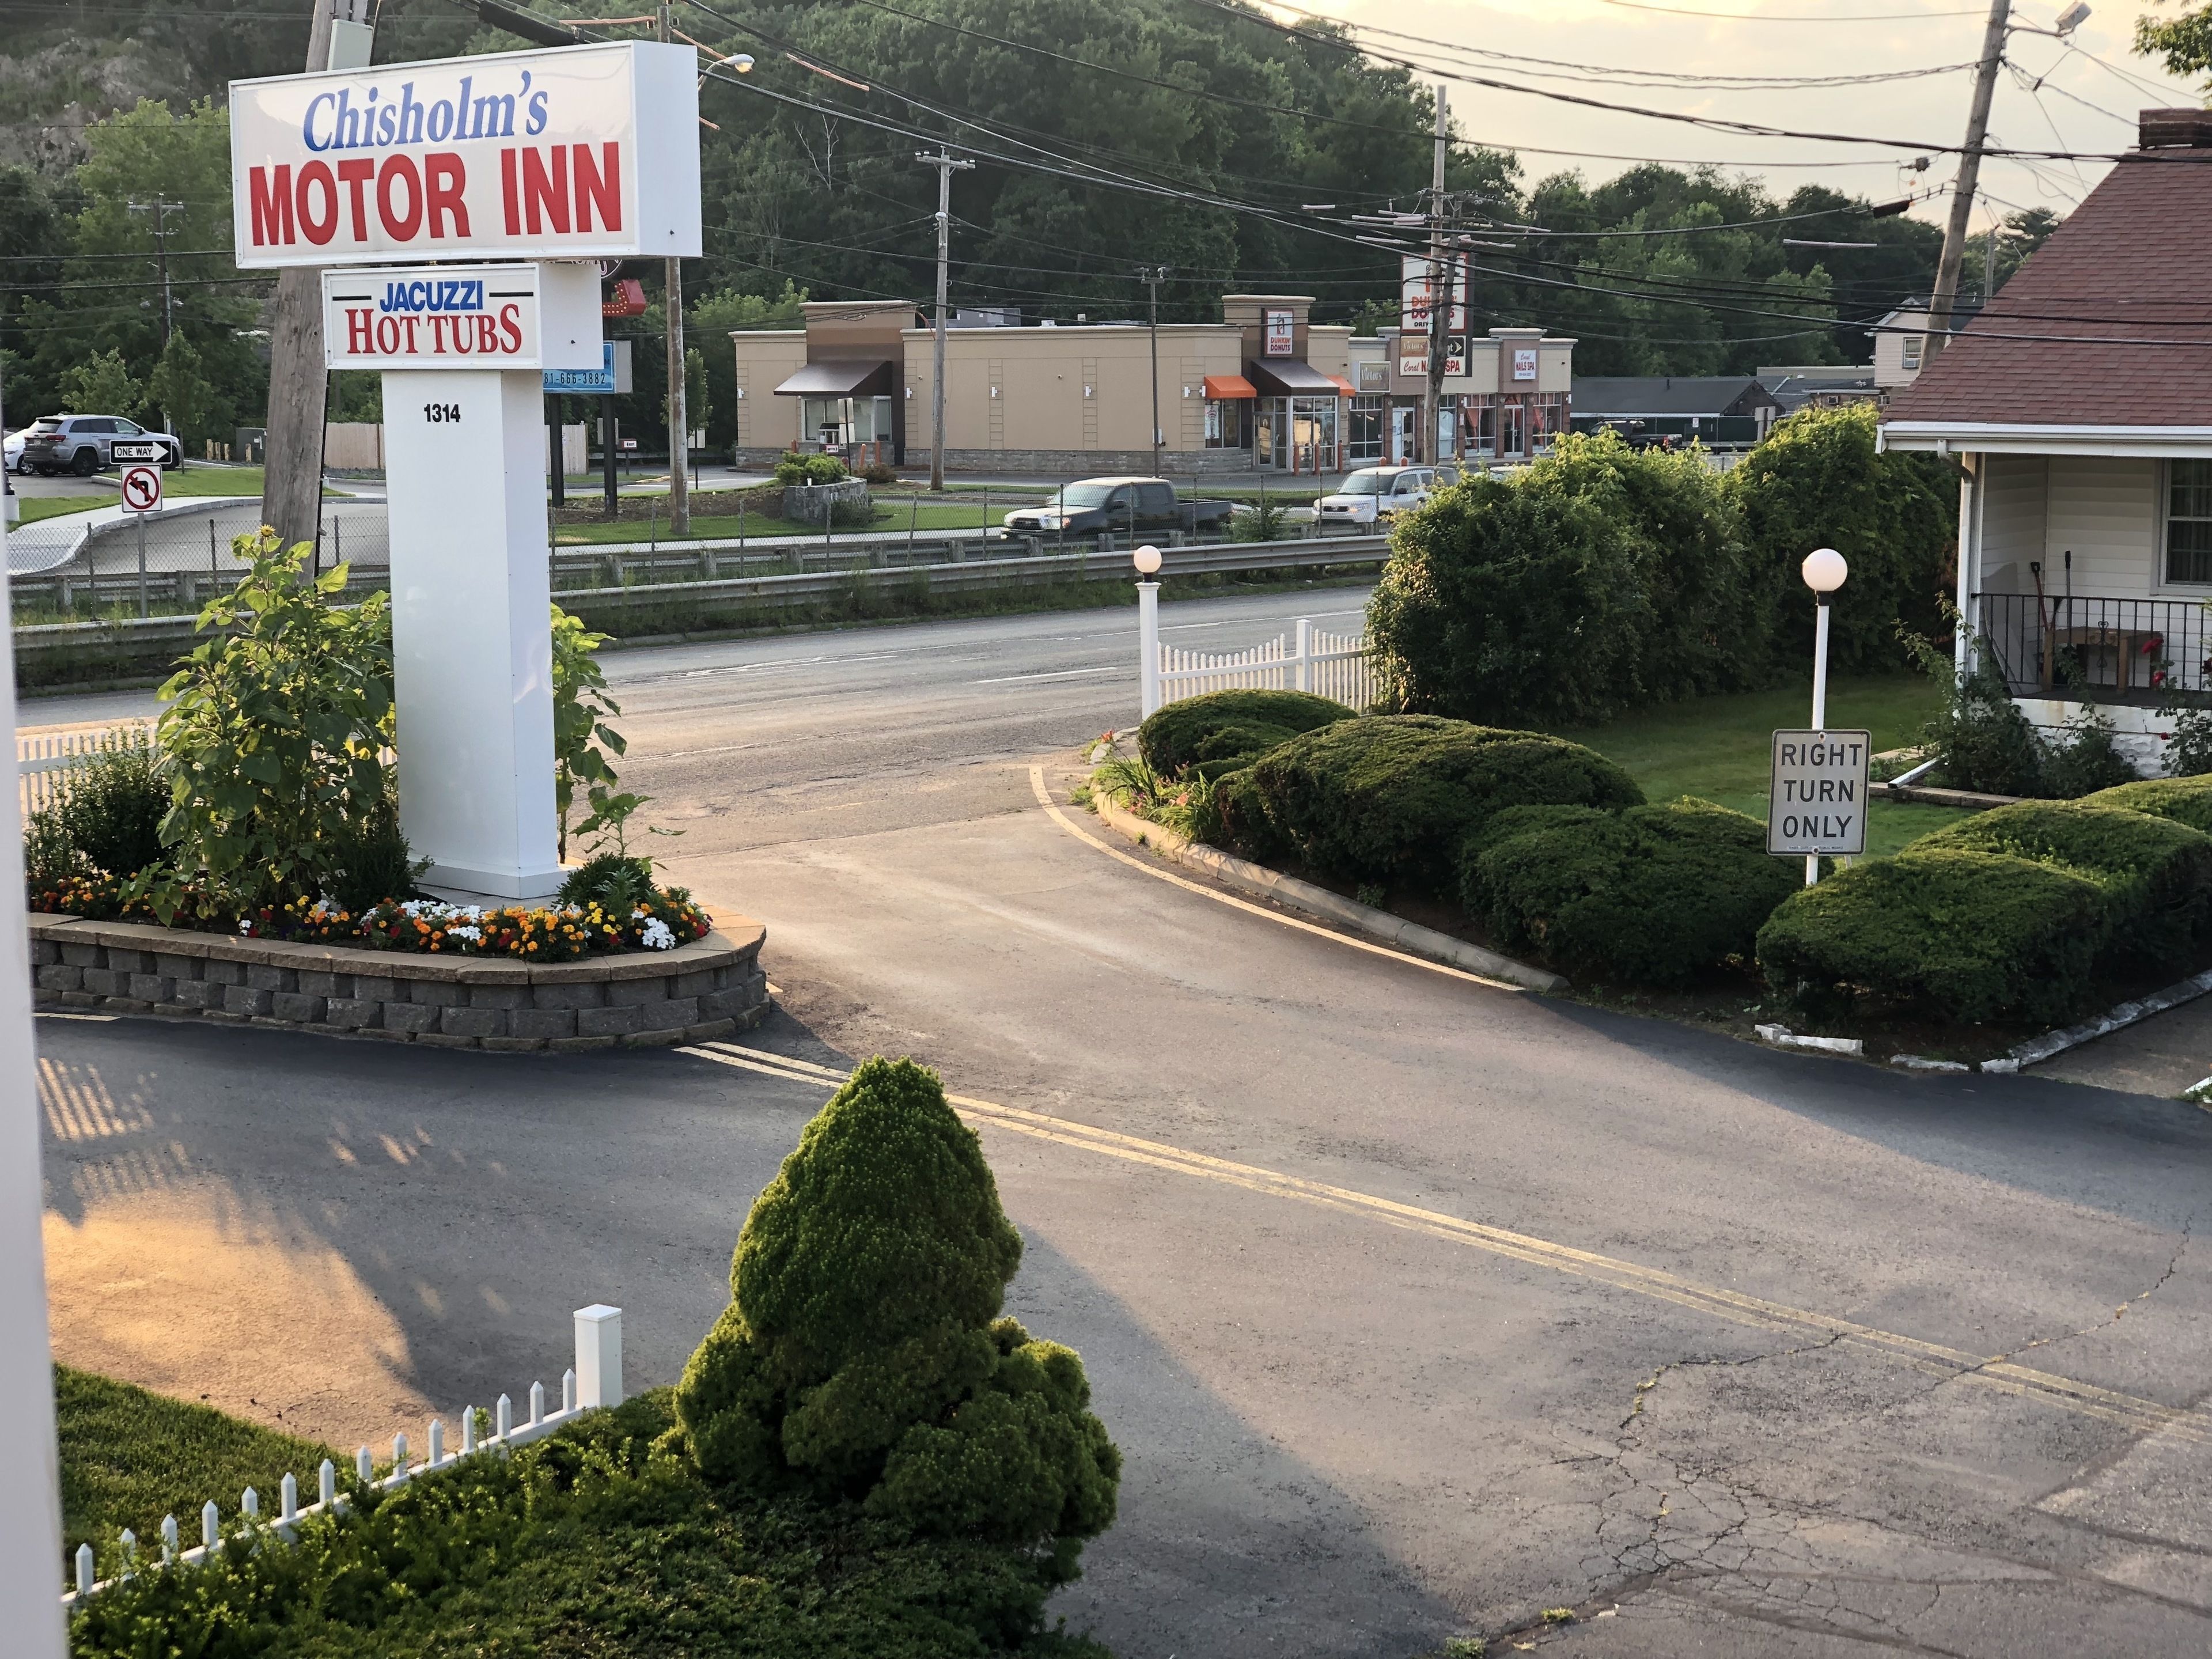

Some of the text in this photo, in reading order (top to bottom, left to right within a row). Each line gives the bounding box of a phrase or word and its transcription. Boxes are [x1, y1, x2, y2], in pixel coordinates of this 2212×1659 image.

[304, 70, 548, 151] Chisholm's
[249, 142, 622, 246] MOTOR INN
[380, 281, 483, 312] JACUZZI
[345, 304, 522, 354] HOT TUBS
[1404, 361, 1420, 372] Coral
[1445, 360, 1460, 372] SPA
[544, 373, 605, 384] 81-666-3882
[424, 404, 461, 422] 1314
[117, 448, 153, 456] ONE WAY
[1781, 744, 1862, 766] RIGHT
[1784, 780, 1854, 802] TURN
[1783, 815, 1852, 838] ONLY
